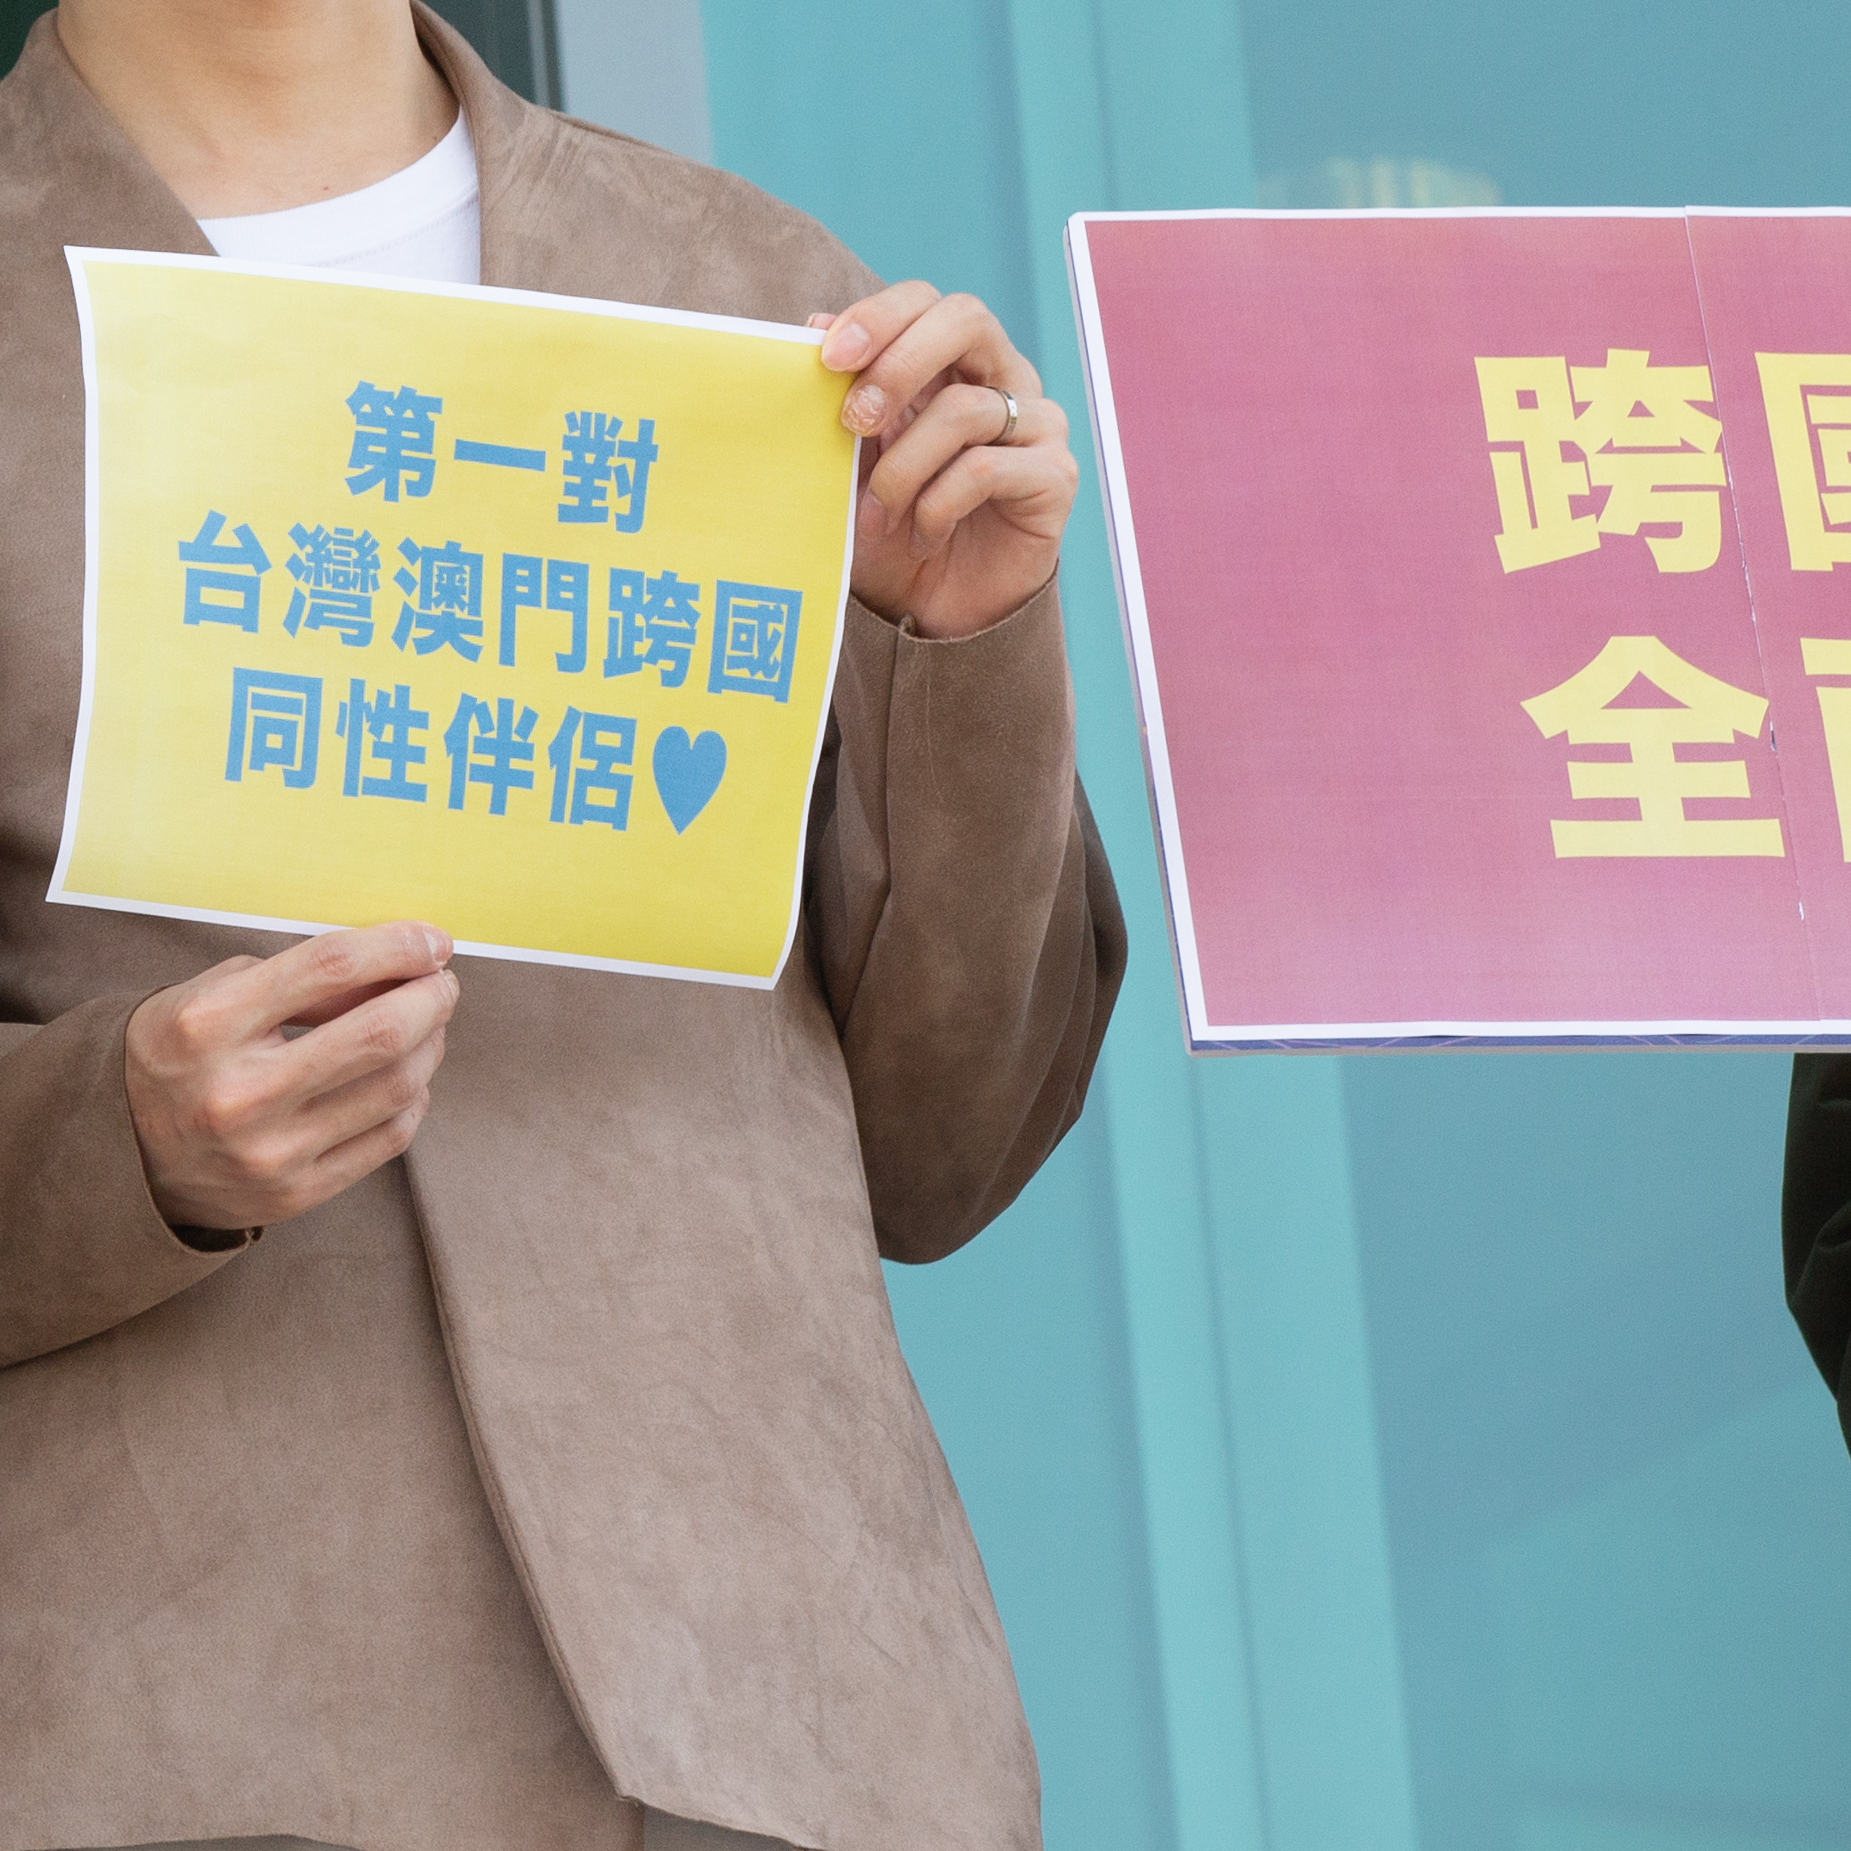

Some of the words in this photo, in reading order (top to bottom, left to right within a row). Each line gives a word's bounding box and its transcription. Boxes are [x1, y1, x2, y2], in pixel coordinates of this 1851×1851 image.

[344, 380, 659, 534] 第一對
[178, 509, 803, 704] 台灣澳門跨國
[224, 666, 637, 832] 同性伴侶
[1520, 635, 1851, 862] 全
